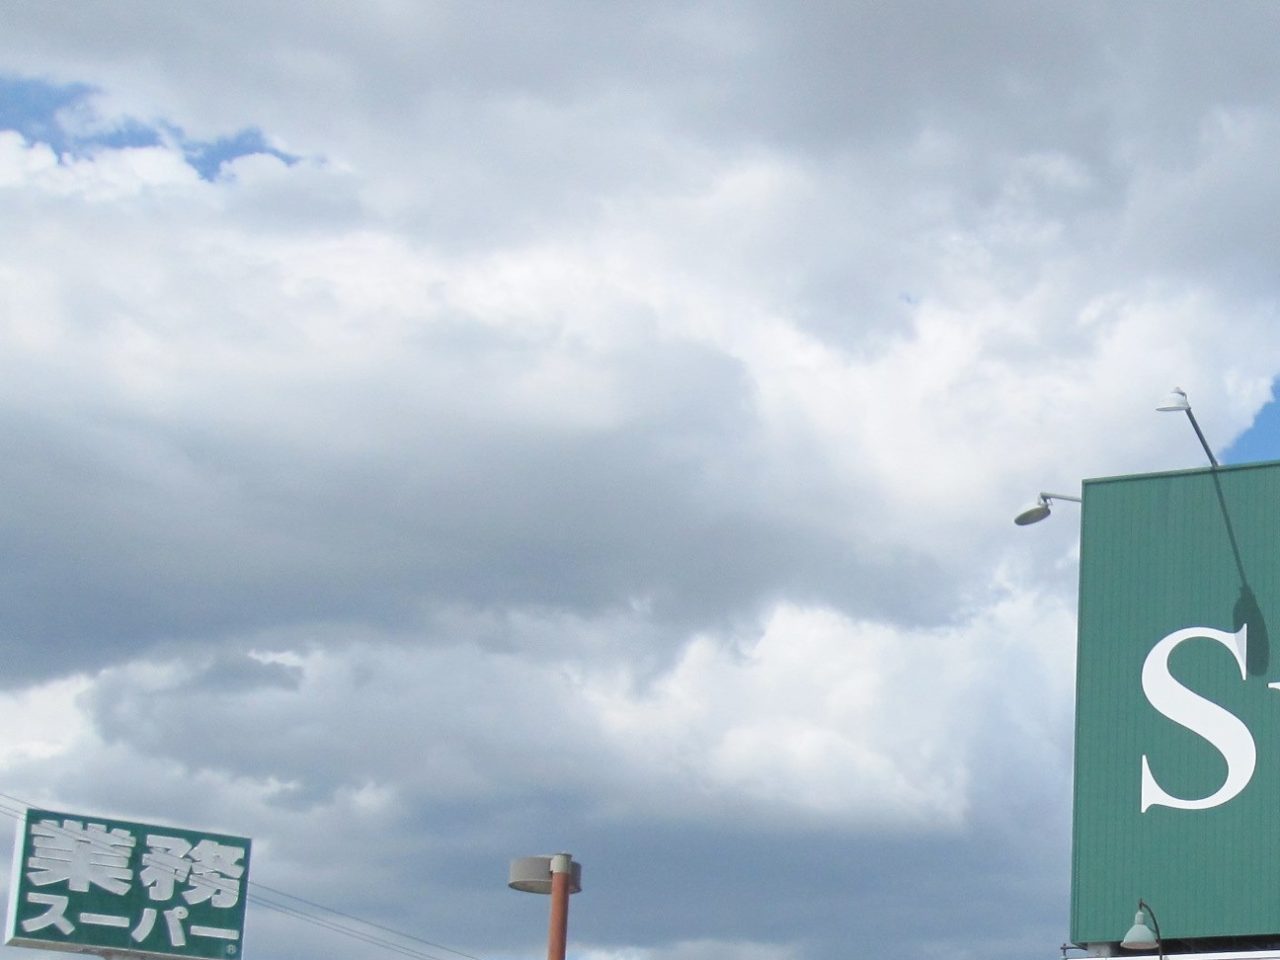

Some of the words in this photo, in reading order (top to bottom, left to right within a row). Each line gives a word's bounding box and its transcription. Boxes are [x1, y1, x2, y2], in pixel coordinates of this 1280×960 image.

[27, 819, 245, 908] 業務
[21, 892, 239, 946] スーパー
